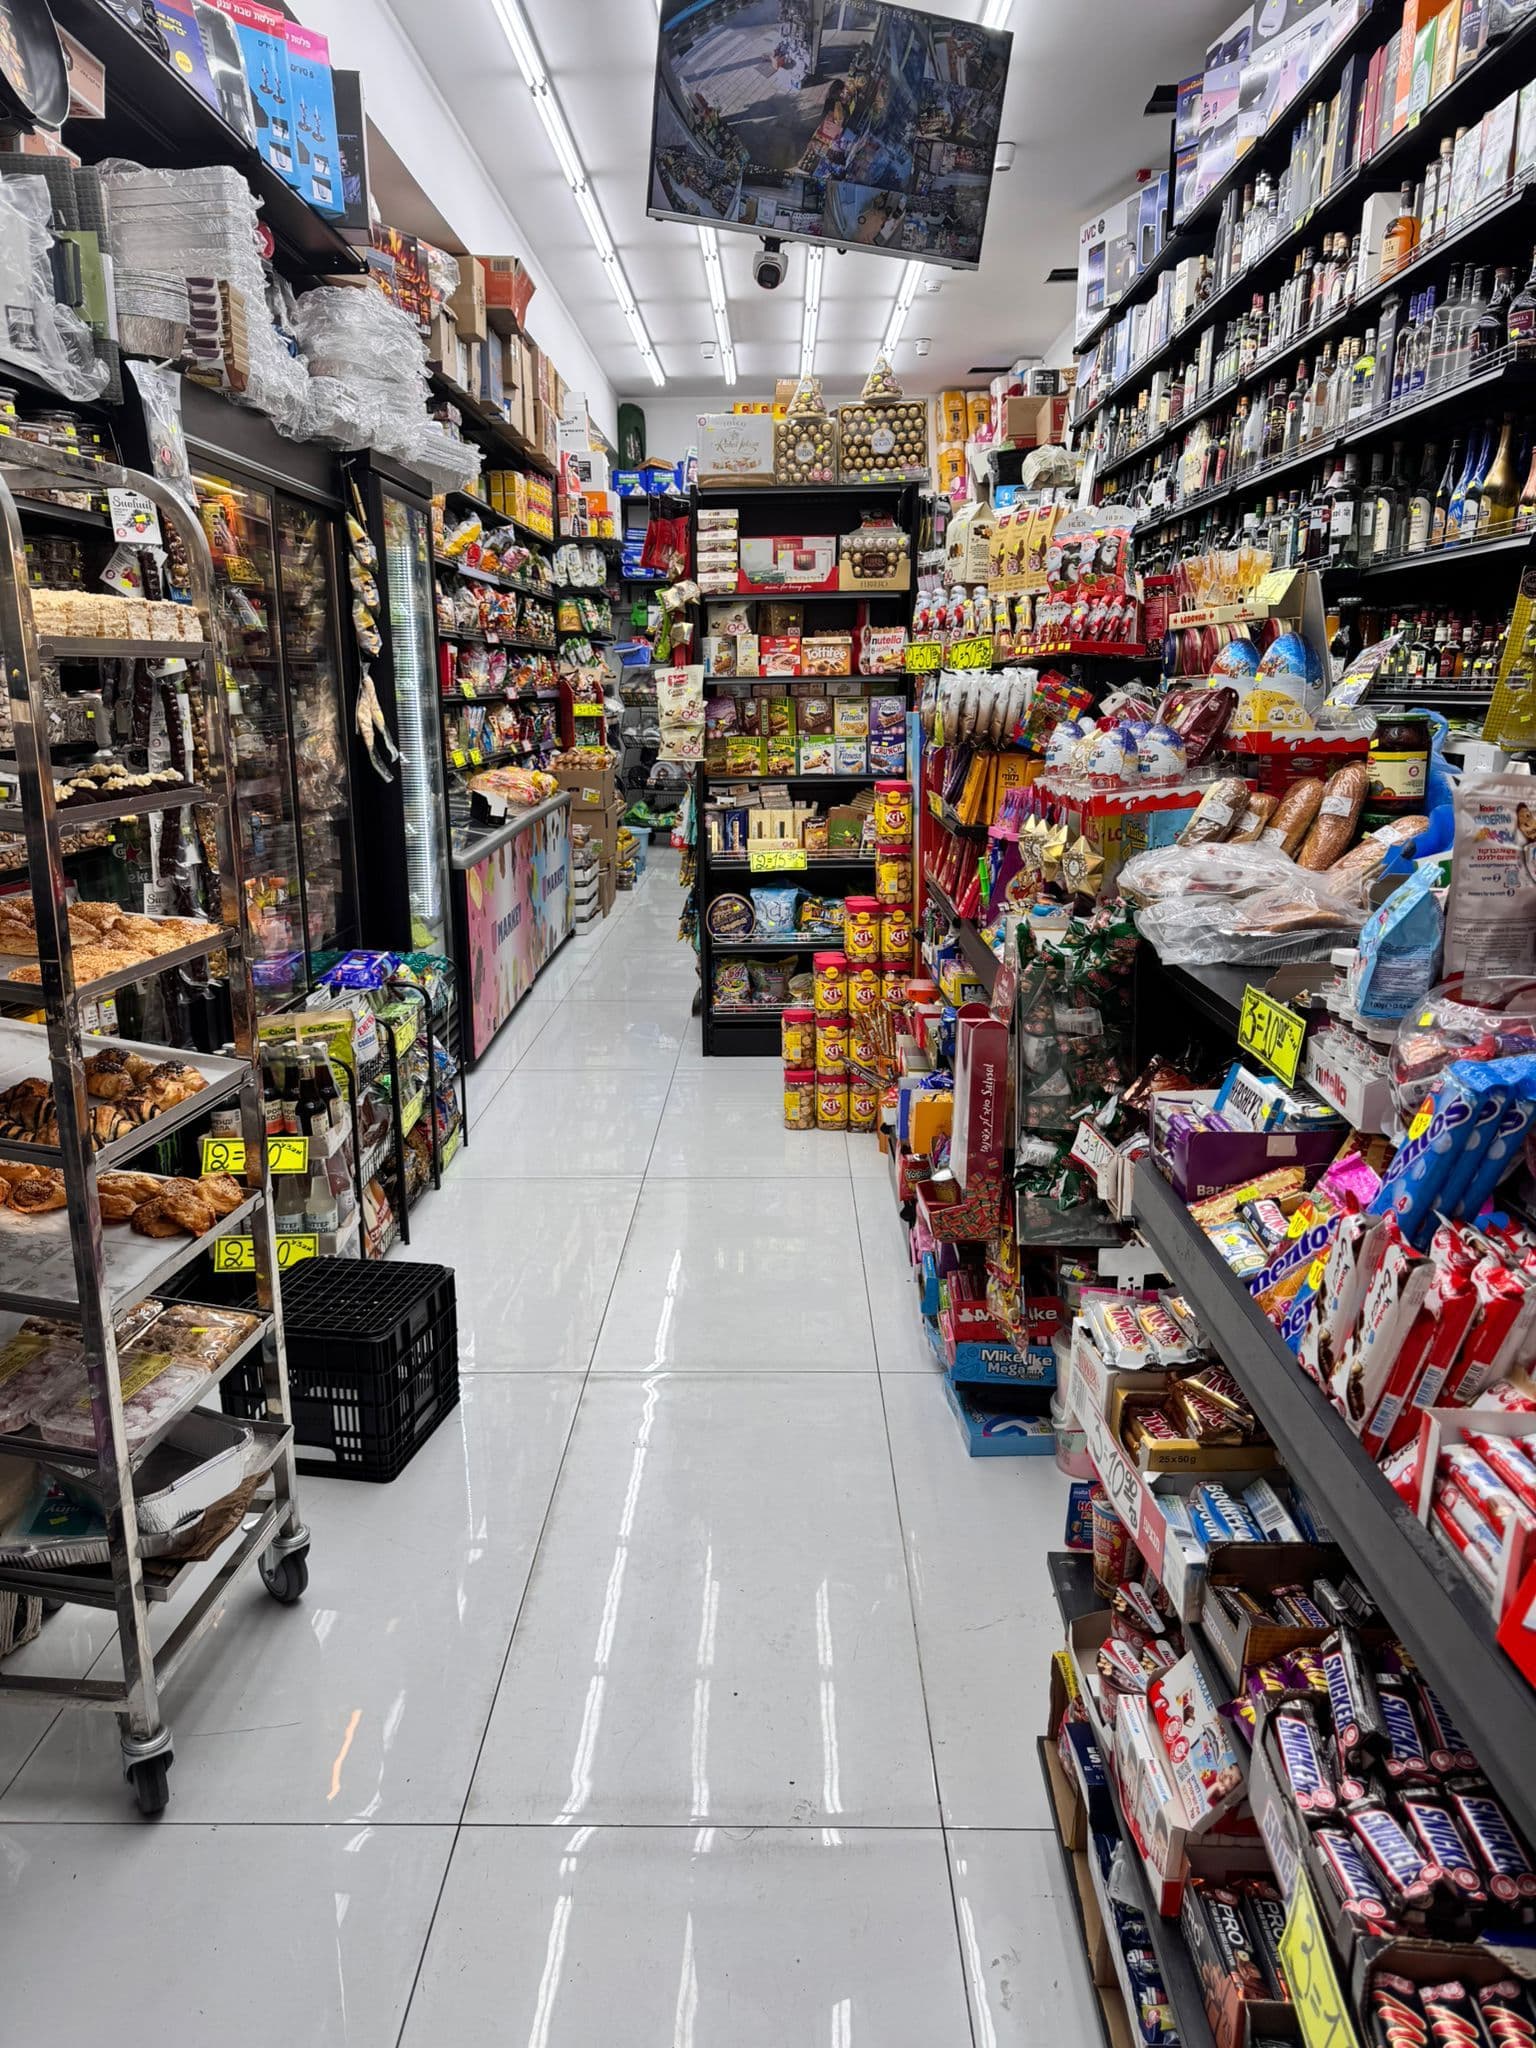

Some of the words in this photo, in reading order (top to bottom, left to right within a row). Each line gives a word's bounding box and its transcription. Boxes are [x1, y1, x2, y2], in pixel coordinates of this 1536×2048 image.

[1081, 225, 1097, 244] JVC
[871, 636, 903, 646] nutella
[801, 646, 848, 661] Toffifee
[840, 712, 864, 723] Fitness
[838, 750, 863, 761] Fitness
[873, 744, 904, 755] CRUNCH
[886, 812, 905, 826] Krit
[854, 930, 873, 944] Krit
[890, 929, 910, 943] Krit
[823, 987, 843, 999] Krit
[856, 988, 876, 999] Krit
[981, 1063, 995, 1096] Salysol
[1315, 1063, 1347, 1108] nutella
[822, 1100, 841, 1111] Krit
[855, 1100, 875, 1111] Krit
[1146, 1308, 1183, 1344] TWIX
[981, 1349, 1022, 1364] Mike
[987, 1362, 1026, 1376] Mega
[1133, 1590, 1153, 1616] nutella
[1118, 1648, 1140, 1675] nutella
[1218, 1902, 1244, 1946] PRO
